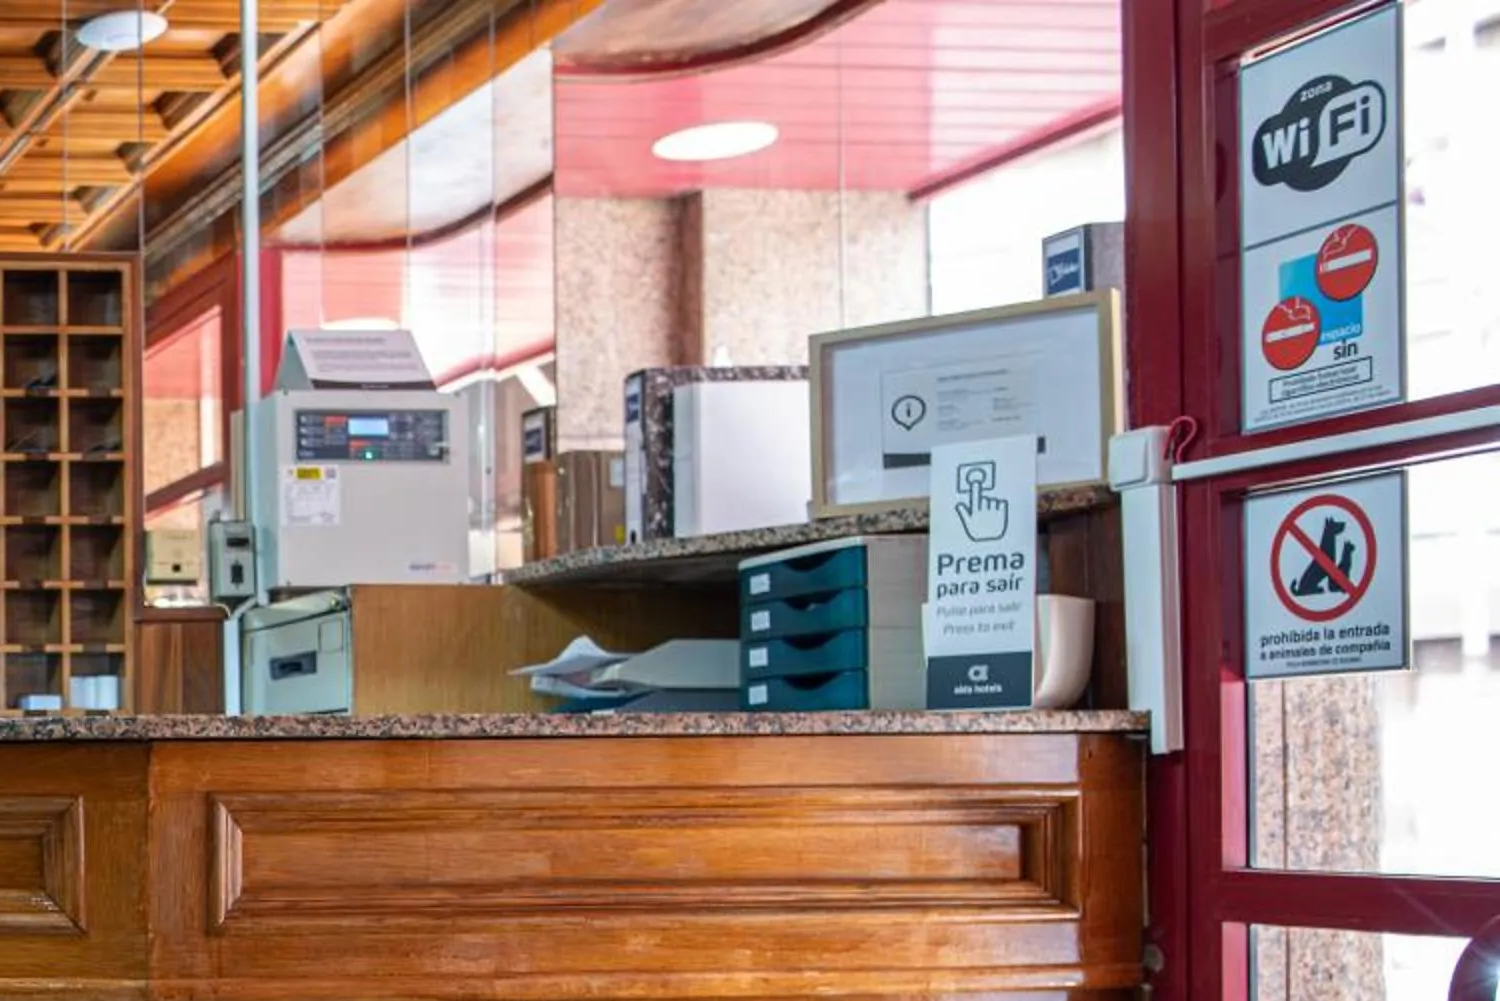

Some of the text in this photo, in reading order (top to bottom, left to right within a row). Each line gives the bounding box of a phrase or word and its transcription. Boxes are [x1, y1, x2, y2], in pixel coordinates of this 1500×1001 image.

[1300, 81, 1333, 102] zona
[1333, 338, 1358, 360] sin
[937, 552, 1025, 576] Prema
[937, 580, 980, 599] para
[1260, 621, 1390, 648] prohibida la entrada
[1260, 652, 1267, 660] a
[1269, 647, 1317, 660] animales
[1319, 644, 1333, 655] de
